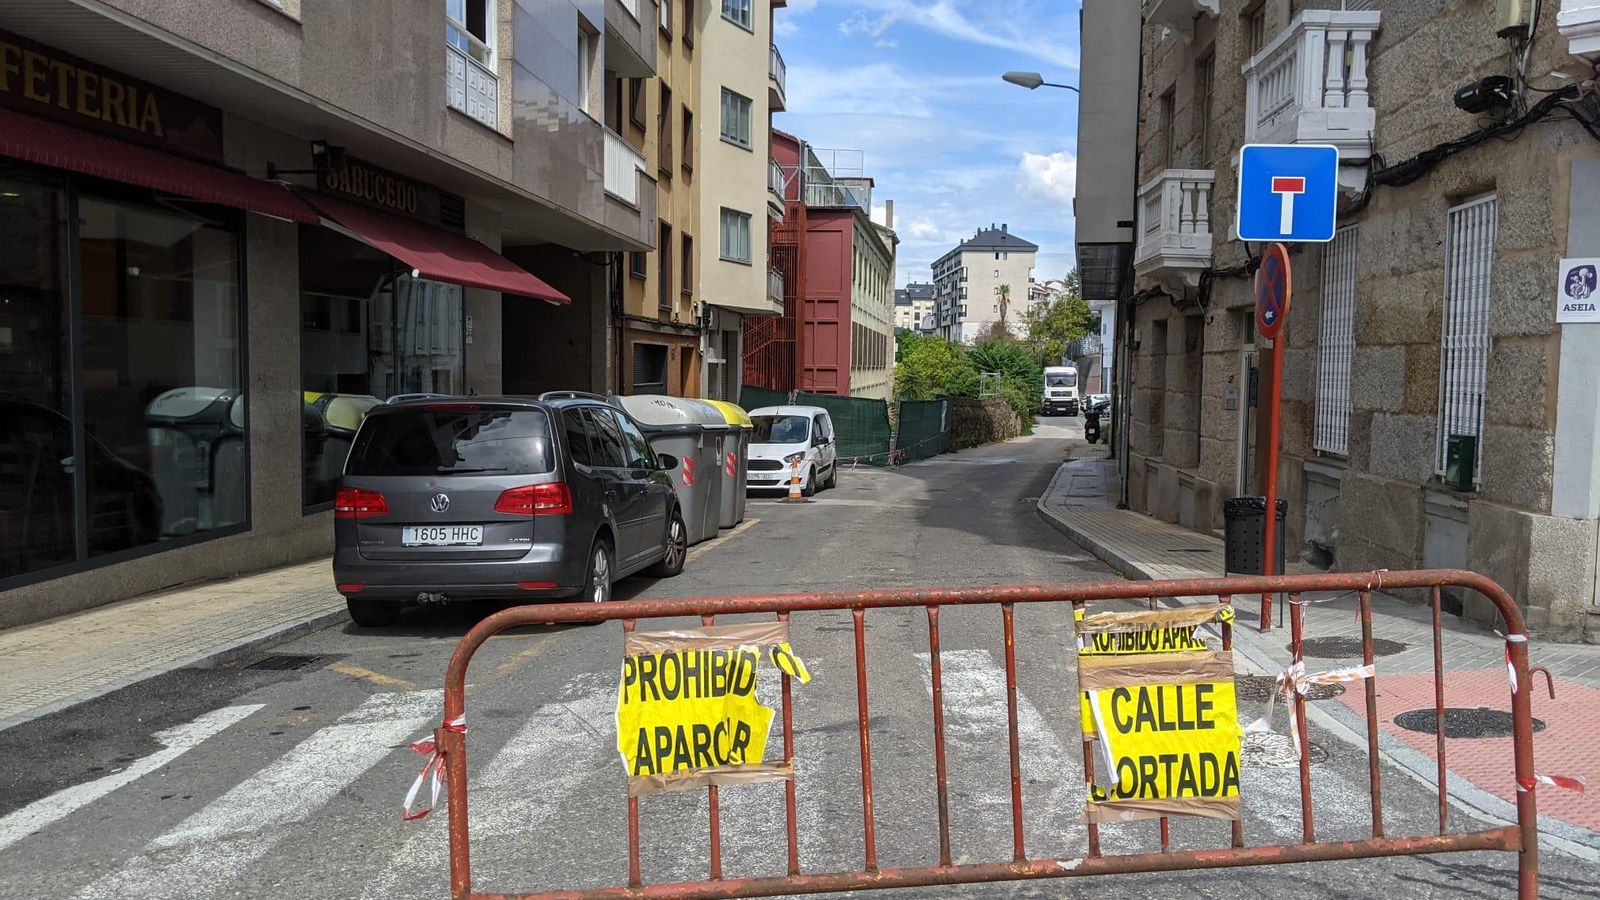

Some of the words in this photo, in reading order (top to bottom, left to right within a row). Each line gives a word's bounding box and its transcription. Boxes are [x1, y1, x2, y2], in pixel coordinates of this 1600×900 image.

[414, 527, 447, 541] 1605
[452, 527, 479, 541] HHC
[1111, 683, 1215, 734] CALLE
[1091, 751, 1240, 801] ORTADA
